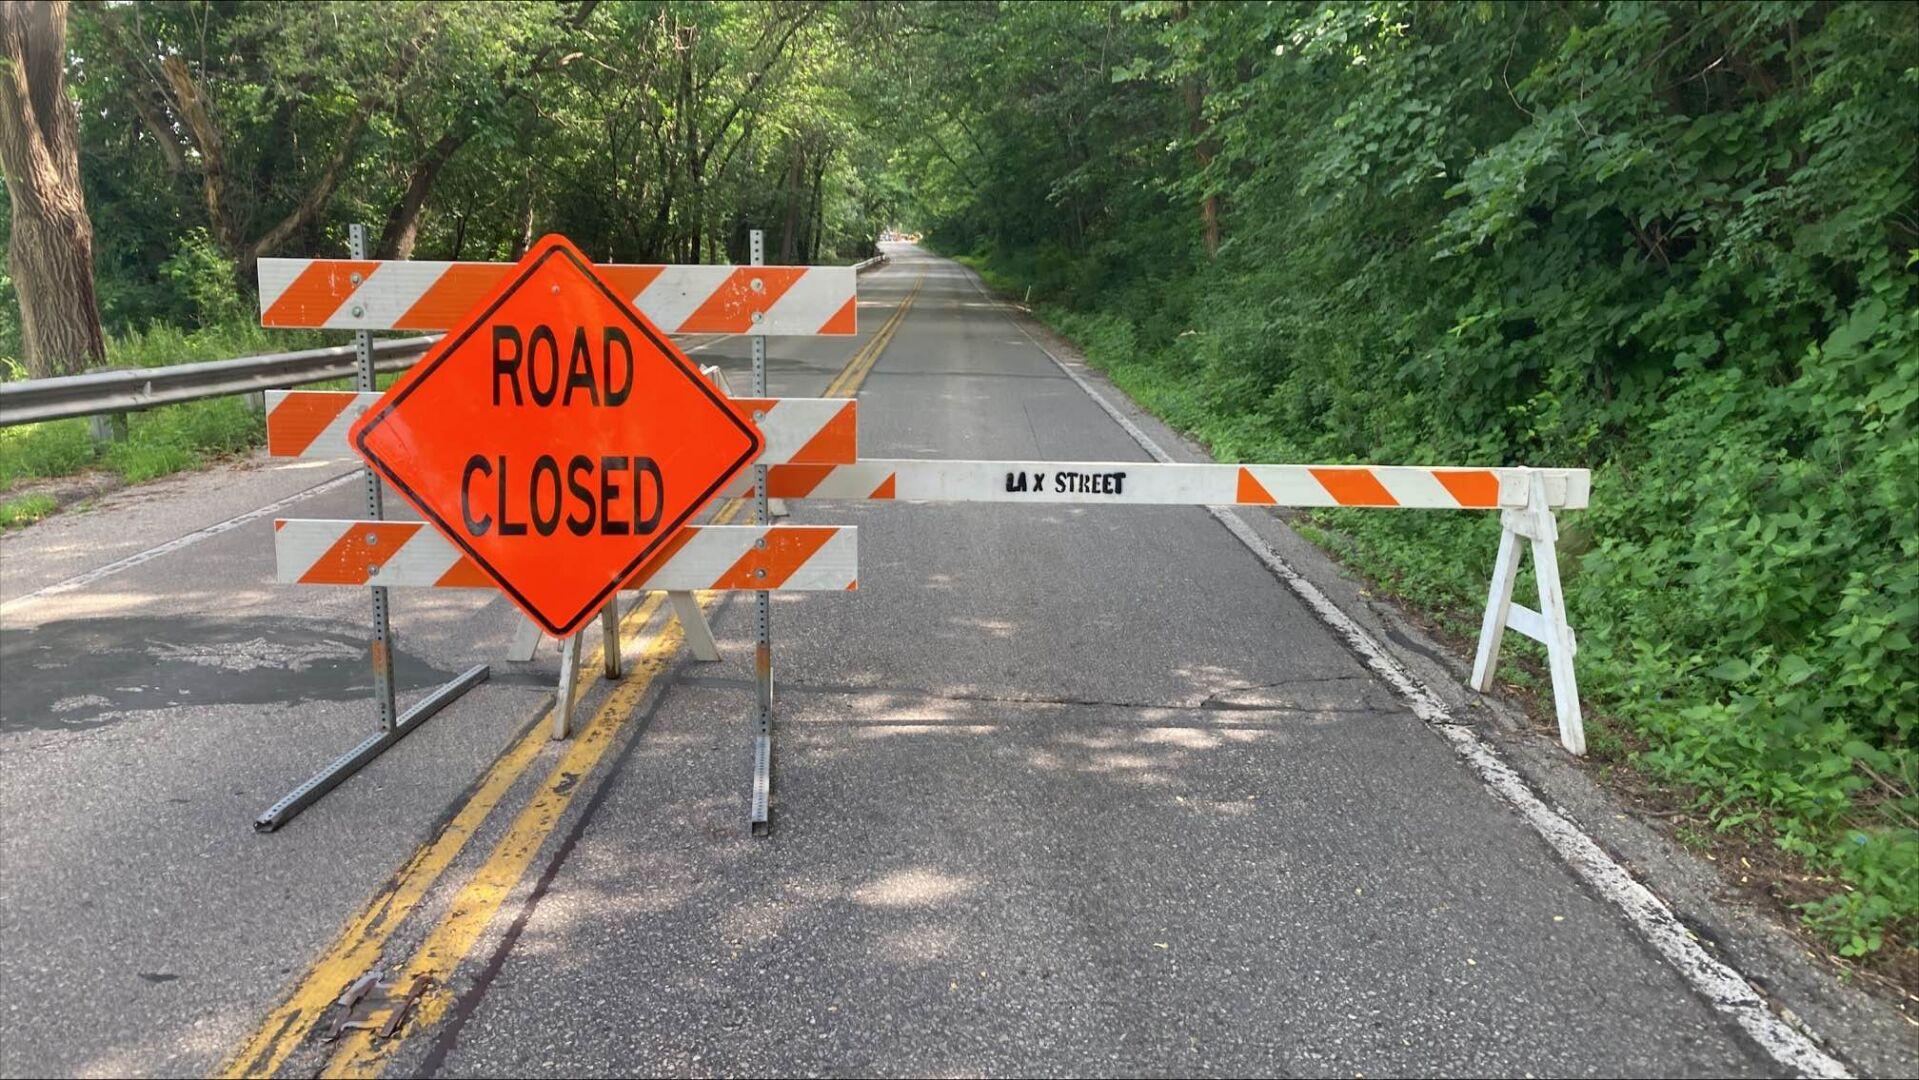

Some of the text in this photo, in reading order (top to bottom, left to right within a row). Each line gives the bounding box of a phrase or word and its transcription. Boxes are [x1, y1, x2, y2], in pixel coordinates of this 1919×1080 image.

[491, 325, 634, 408] ROAD
[460, 454, 664, 536] CLOSED
[1055, 472, 1126, 494] STREET
